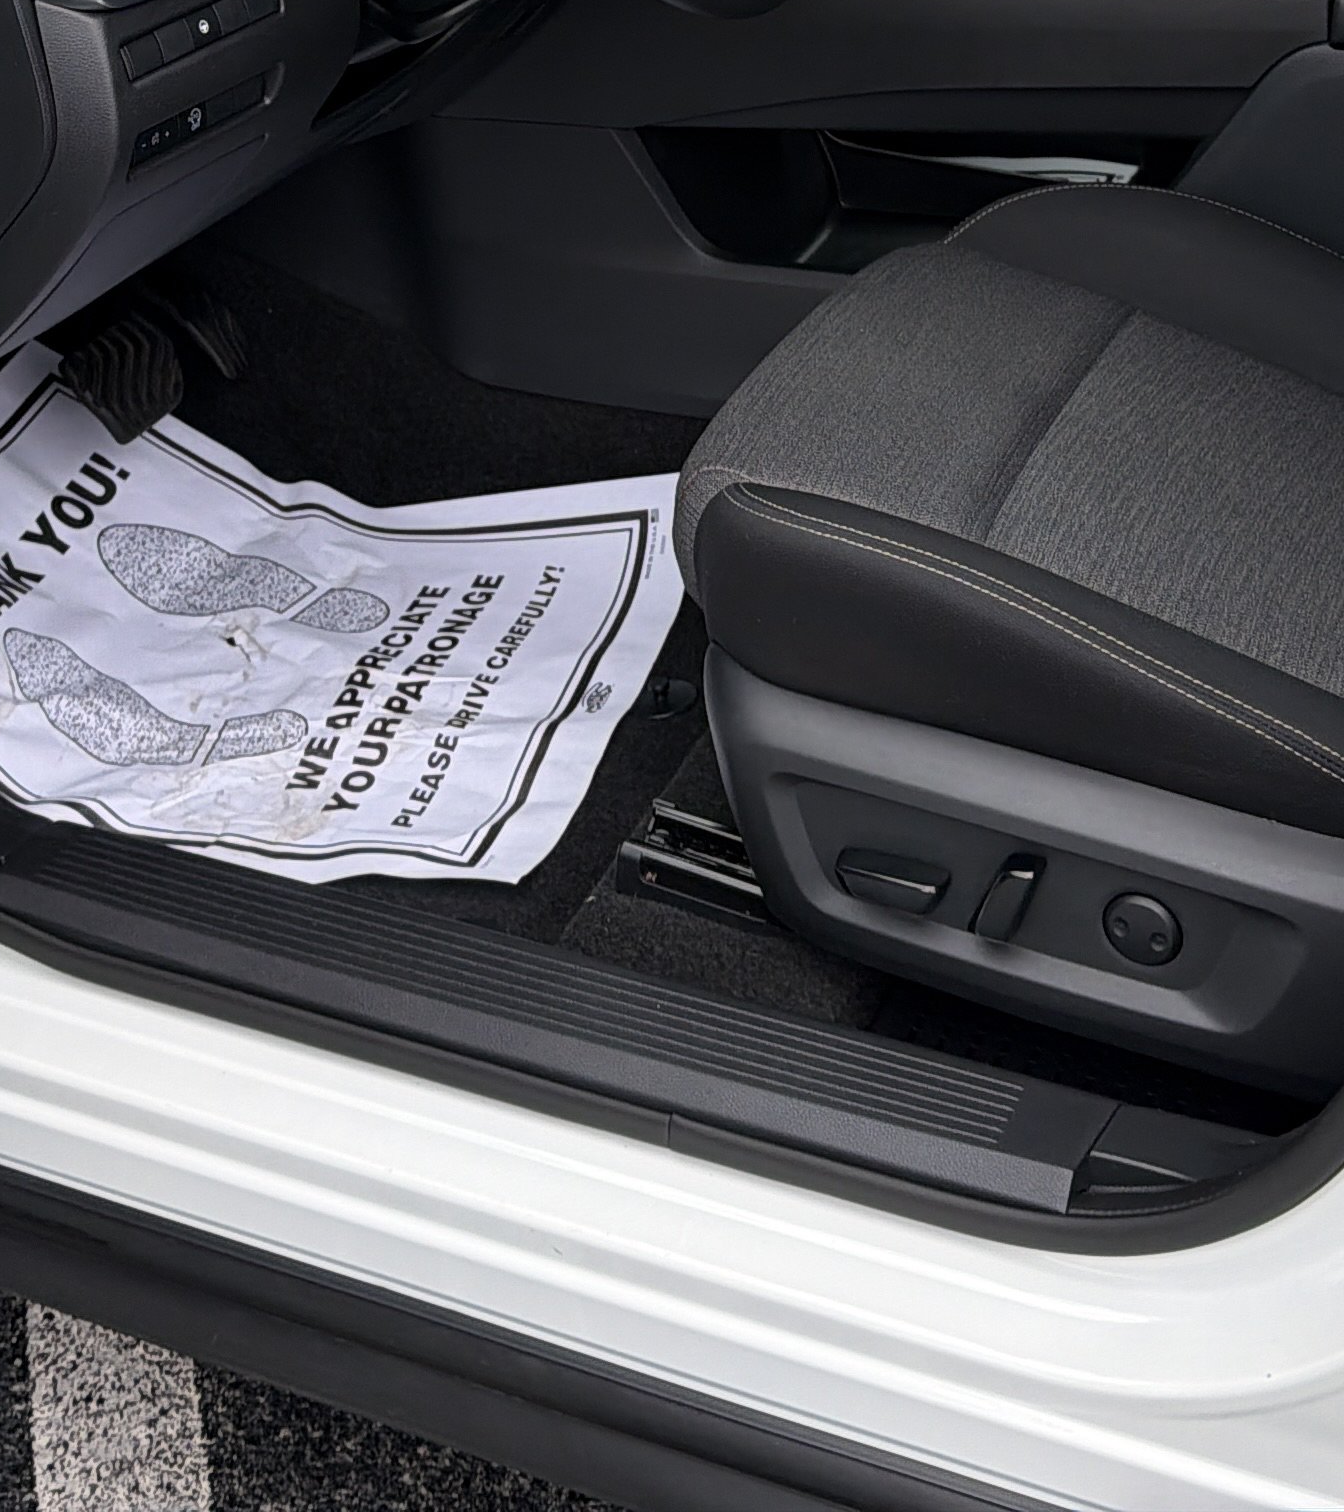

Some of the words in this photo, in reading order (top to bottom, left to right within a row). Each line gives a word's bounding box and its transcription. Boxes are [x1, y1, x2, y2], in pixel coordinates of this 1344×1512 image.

[19, 452, 130, 555] YOU!
[285, 736, 340, 790] WE
[325, 585, 451, 731] APPRECIATE
[382, 574, 505, 714] PATRONAGE
[391, 732, 460, 828] PLEASE
[443, 673, 500, 729] DRIVE
[486, 564, 565, 670] CAREFULLY!
